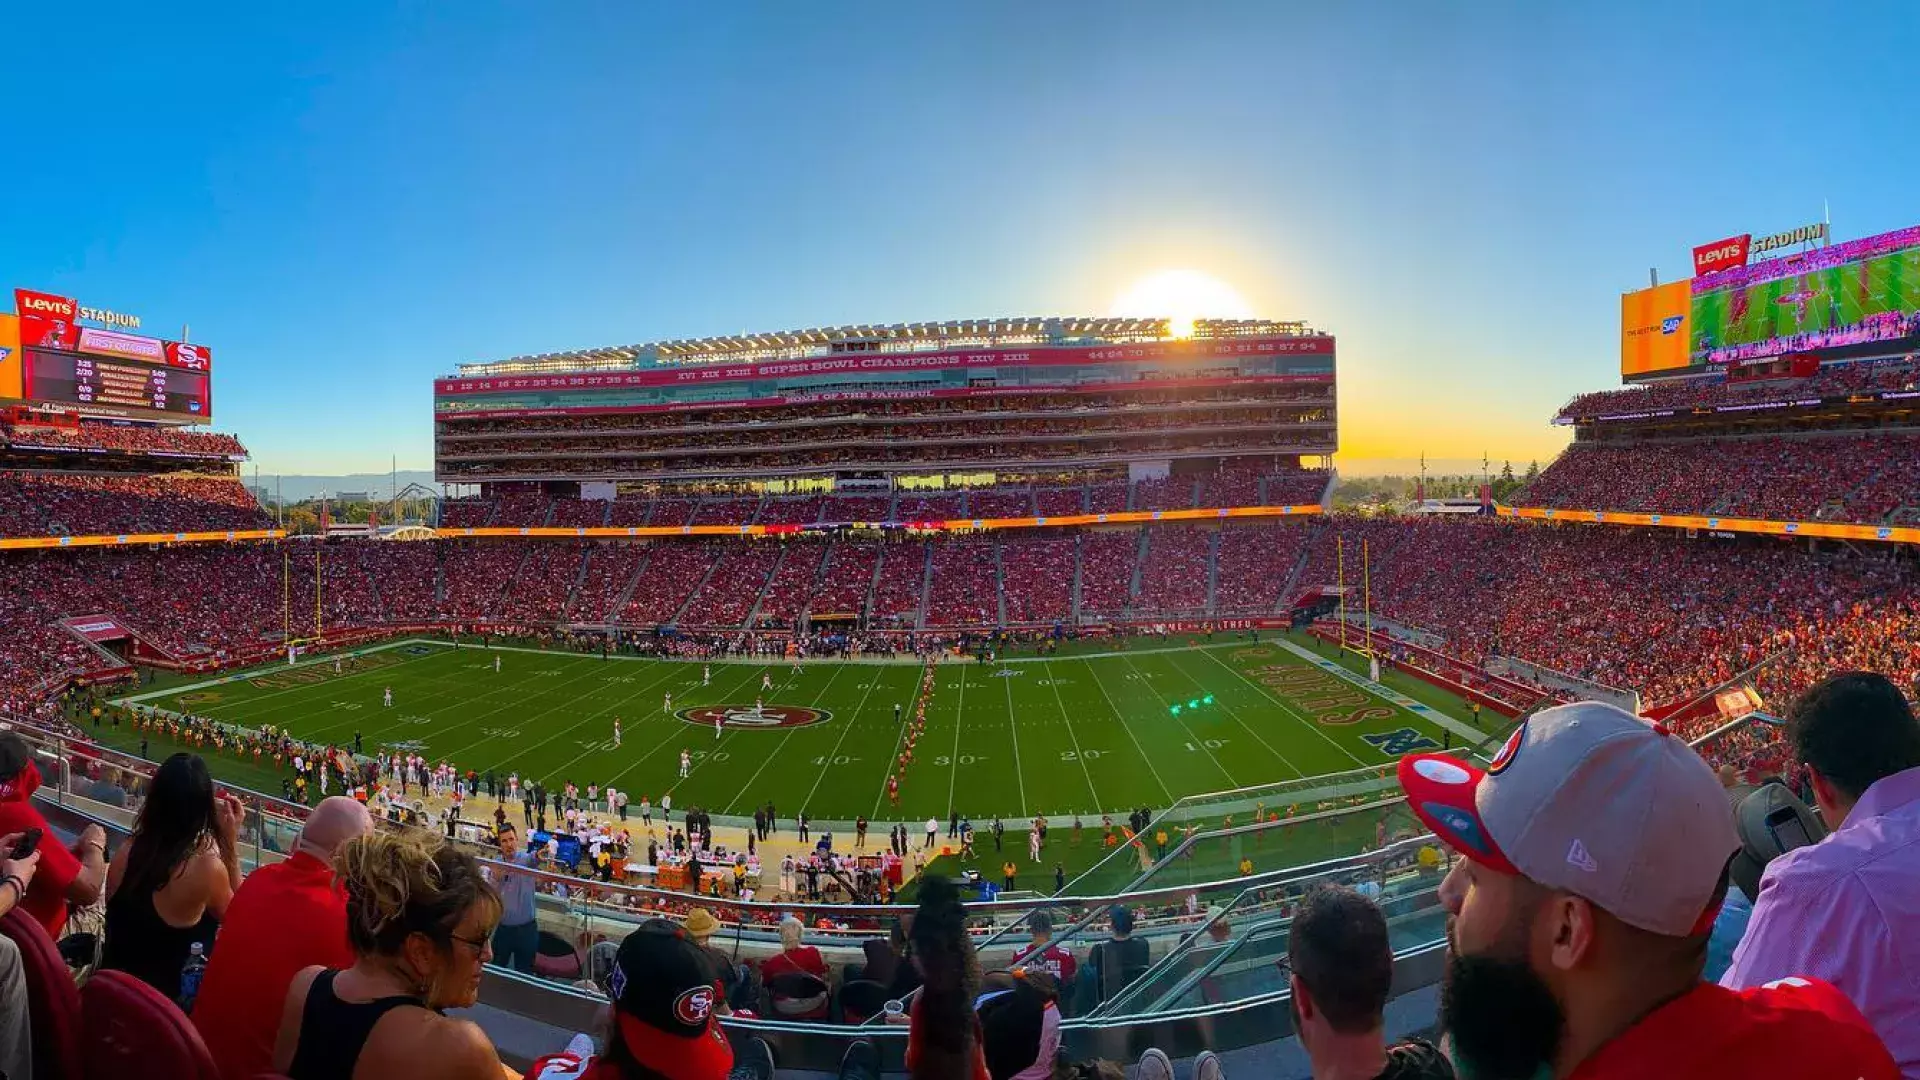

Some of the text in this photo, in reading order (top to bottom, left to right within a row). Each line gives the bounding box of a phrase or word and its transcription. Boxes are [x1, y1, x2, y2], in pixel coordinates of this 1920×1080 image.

[1752, 224, 1824, 253] STADIUM
[80, 307, 140, 327] STADIUM
[1662, 319, 1680, 332] SAP
[759, 355, 960, 375] SUPER BOWL CHAMPIONS
[1184, 739, 1223, 752] 10
[812, 756, 850, 766] 40
[934, 755, 975, 767] 30
[1061, 750, 1100, 762] 20
